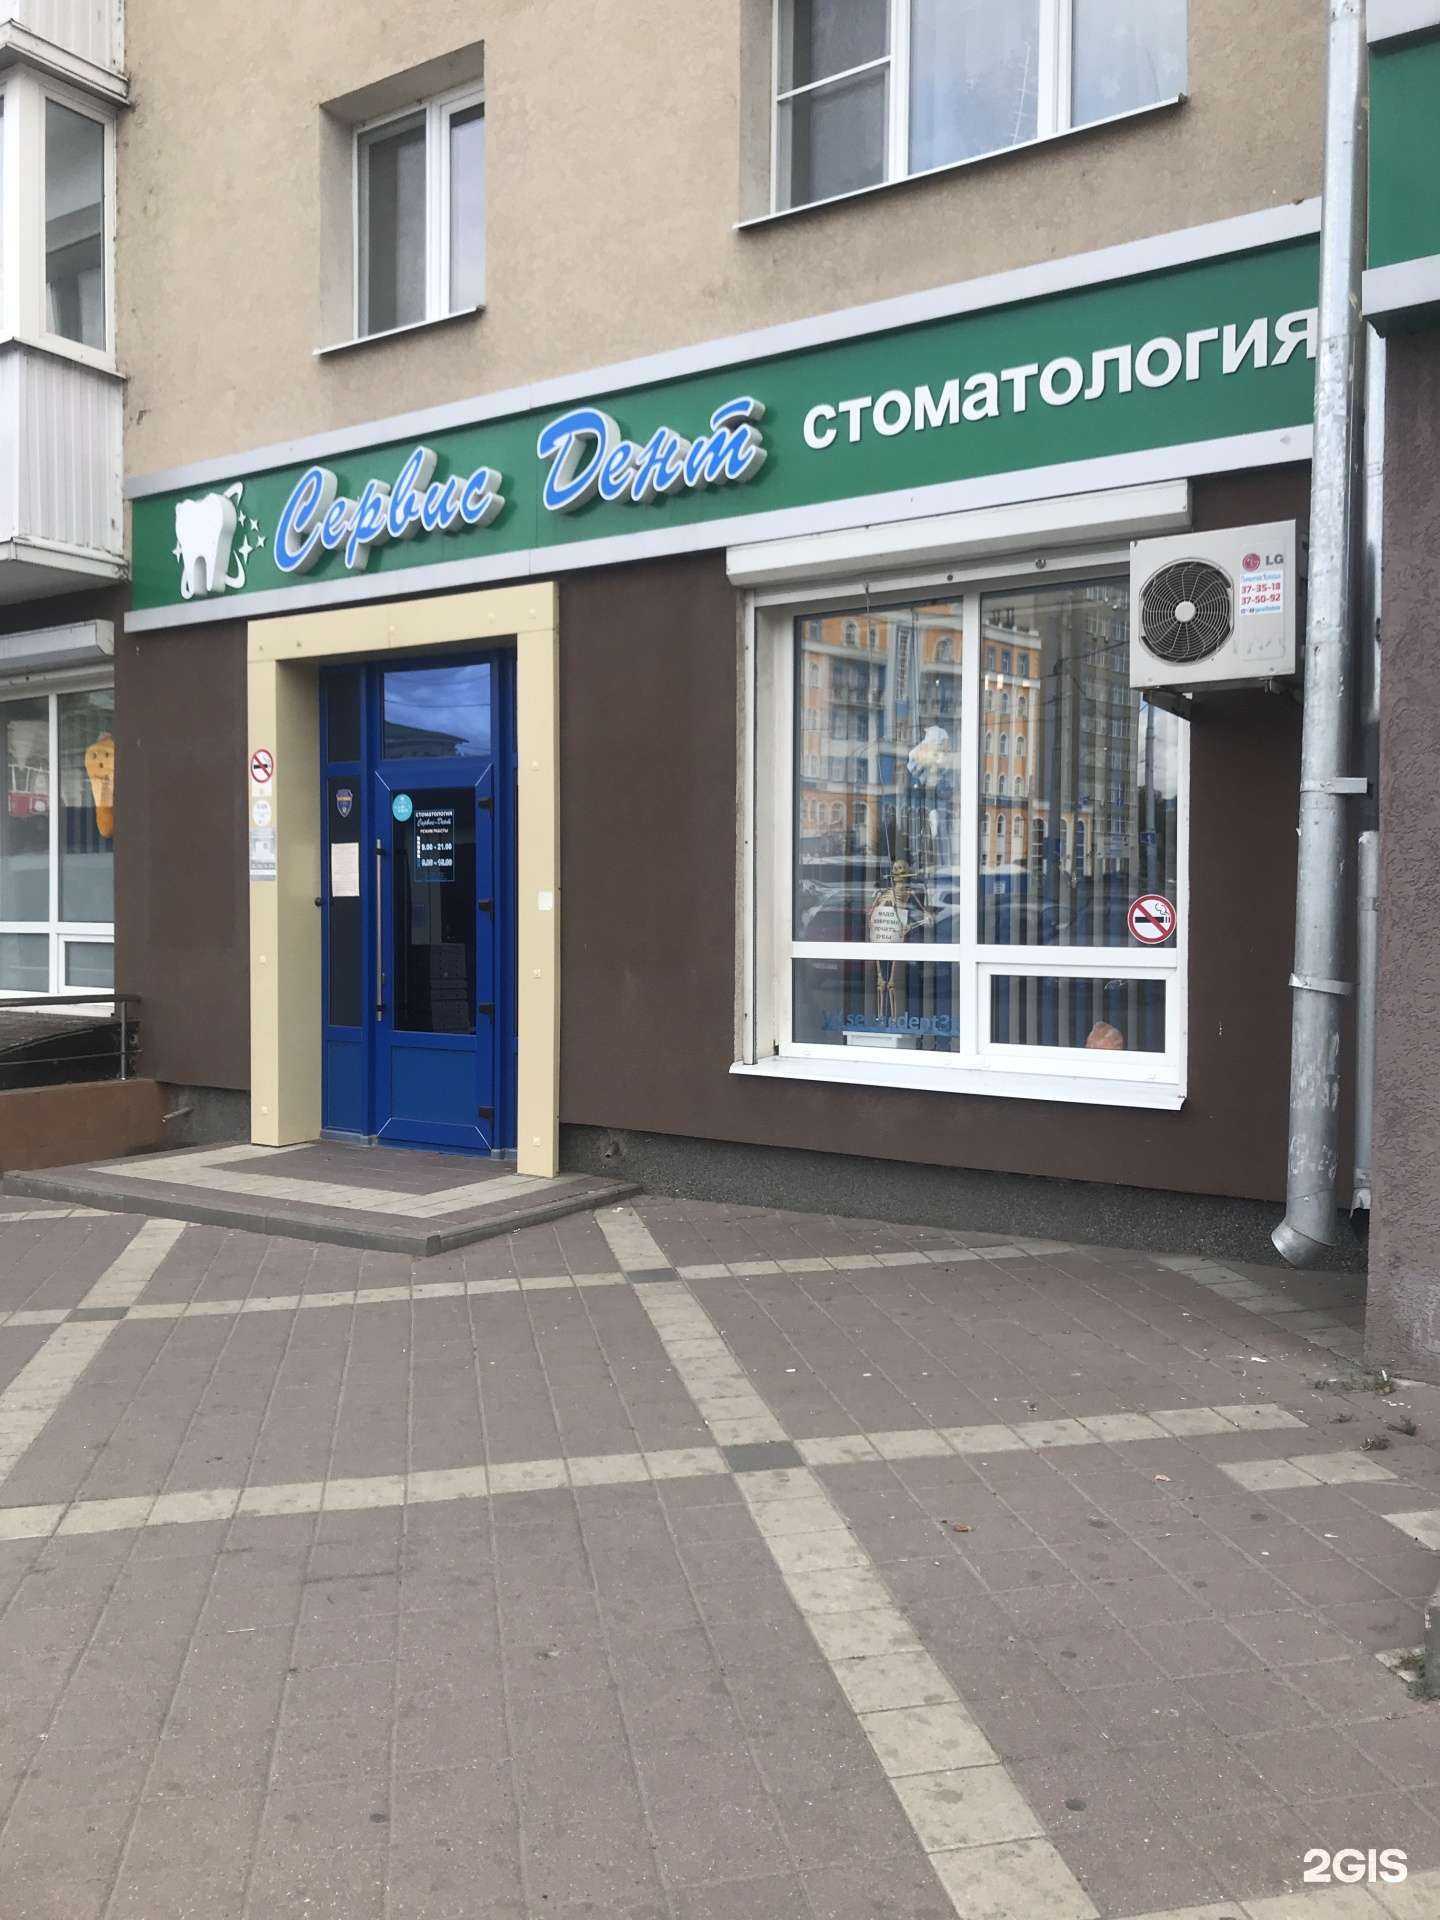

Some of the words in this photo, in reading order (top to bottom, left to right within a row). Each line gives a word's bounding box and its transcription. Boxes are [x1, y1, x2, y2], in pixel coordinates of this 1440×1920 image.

[275, 446, 503, 572] Сервис
[537, 396, 766, 512] Дент
[1265, 554, 1284, 566] LG
